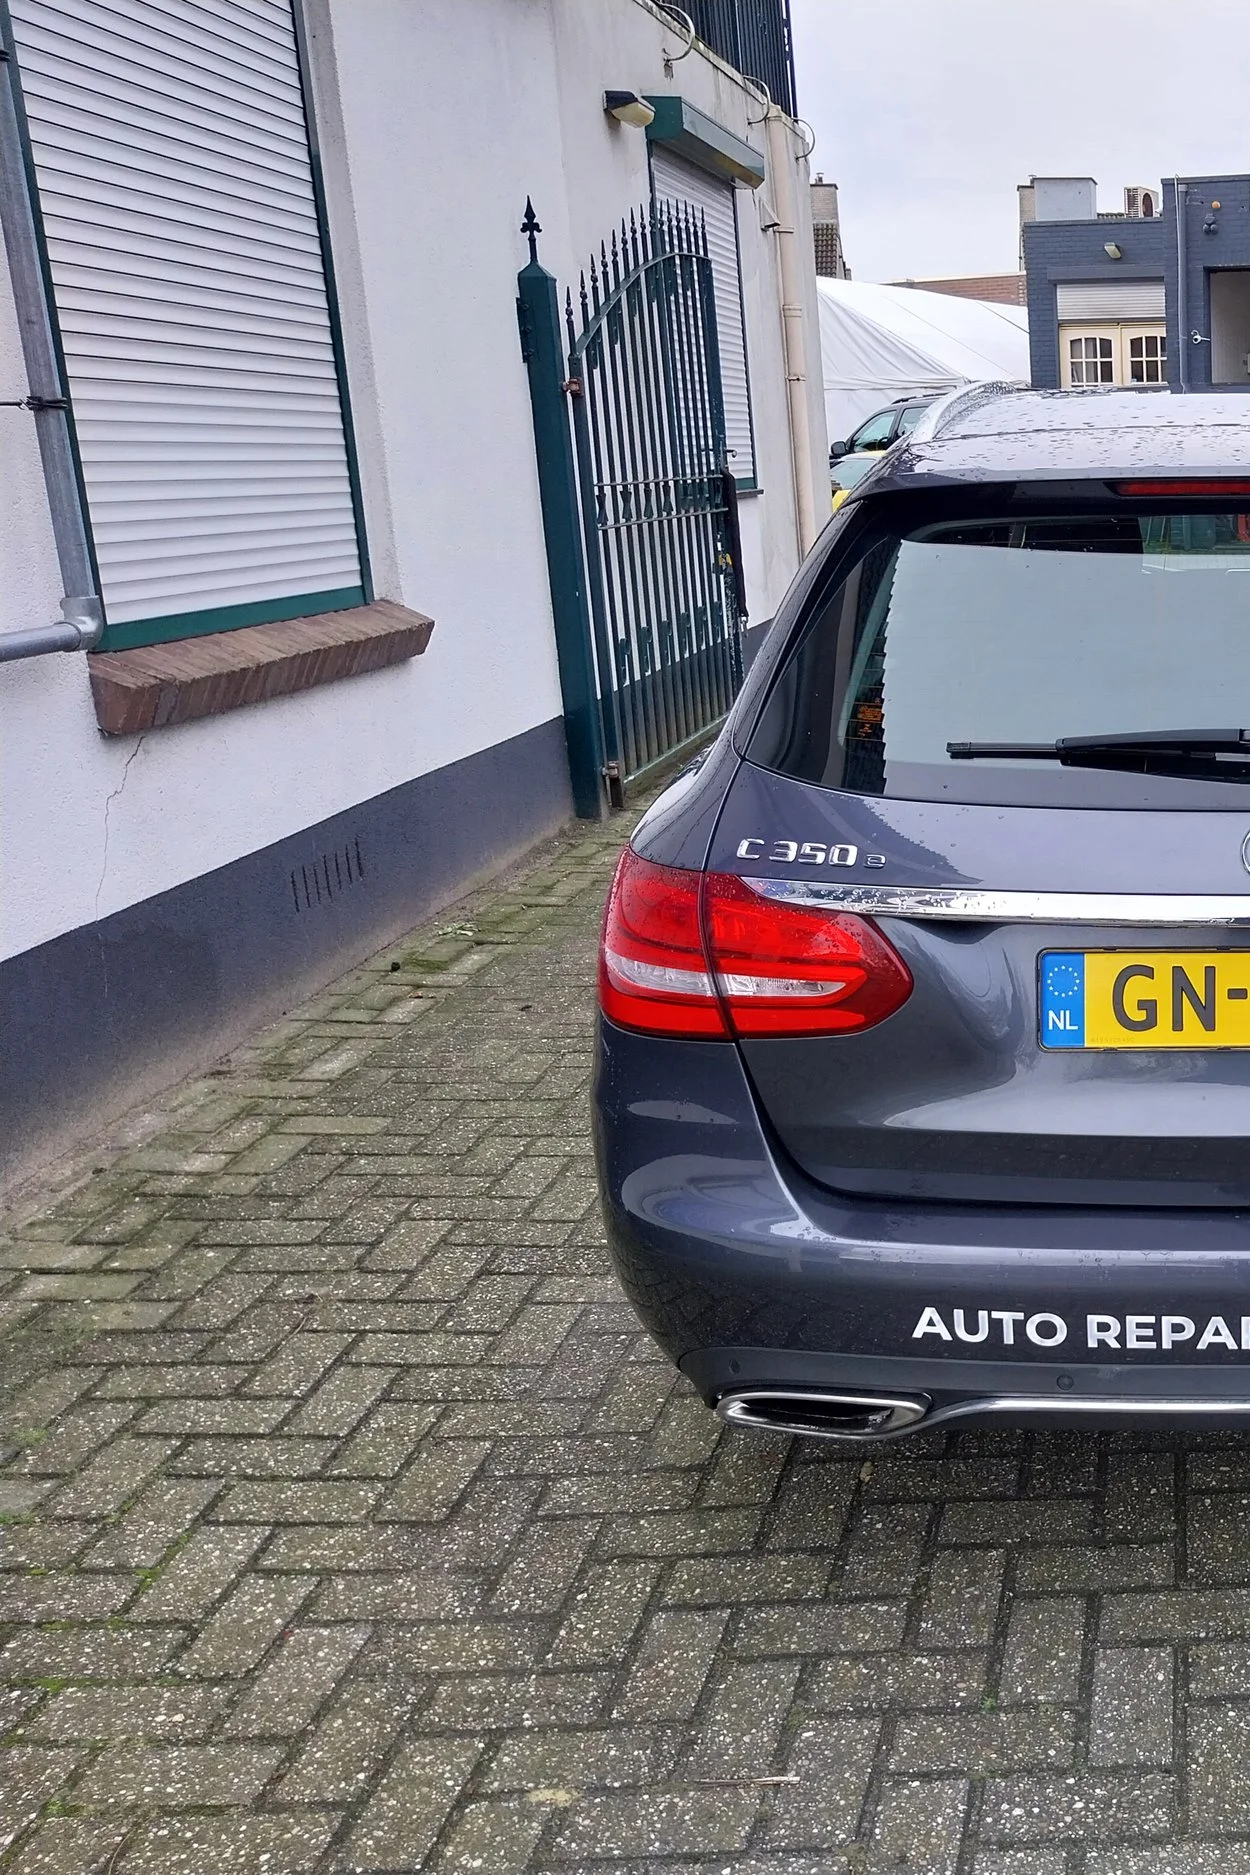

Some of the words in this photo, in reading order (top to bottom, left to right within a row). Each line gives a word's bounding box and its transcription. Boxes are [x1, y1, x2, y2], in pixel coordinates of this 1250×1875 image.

[736, 838, 765, 859] C
[768, 840, 858, 867] 350
[1048, 1009, 1079, 1031] NL
[912, 1306, 1068, 1347] AUTO
